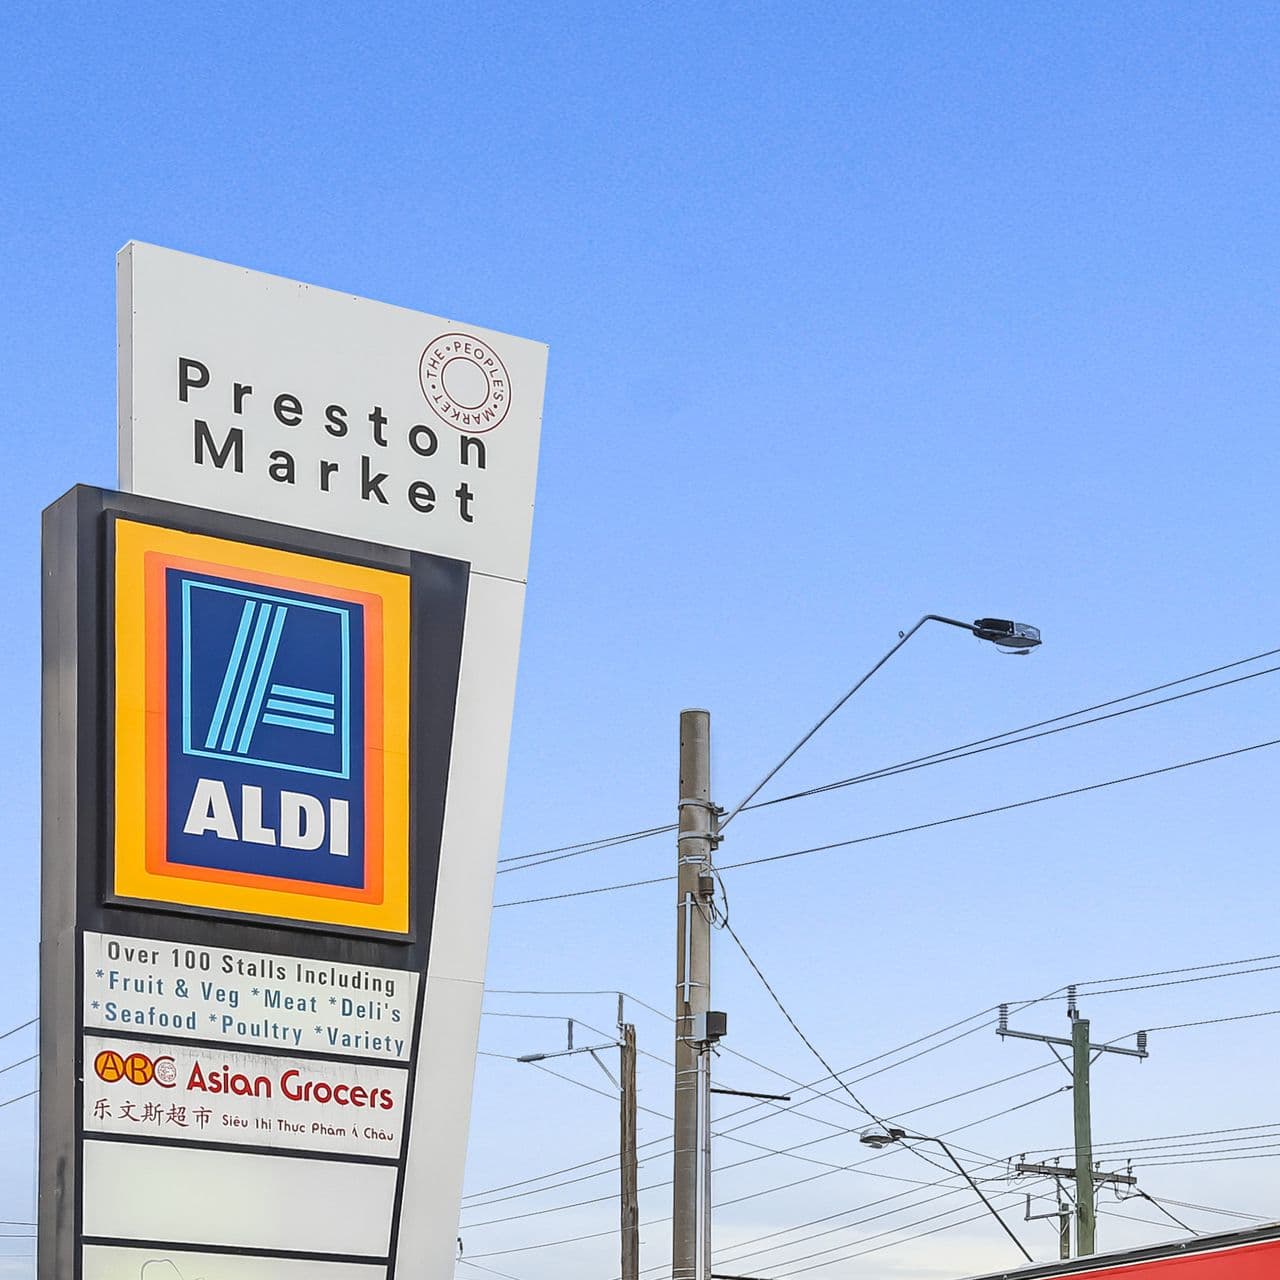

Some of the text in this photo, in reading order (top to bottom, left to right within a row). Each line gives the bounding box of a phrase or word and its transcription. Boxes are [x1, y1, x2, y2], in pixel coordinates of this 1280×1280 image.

[177, 356, 487, 470] Preston
[426, 341, 504, 425] THE PEOPLE'S MARKET
[193, 418, 475, 523] Market
[182, 777, 350, 857] ALDI
[107, 941, 396, 998] Over 100 Stalls Including
[175, 979, 189, 998] &
[201, 981, 240, 1009] Veg
[94, 1050, 394, 1110] ARC Asian Grocers
